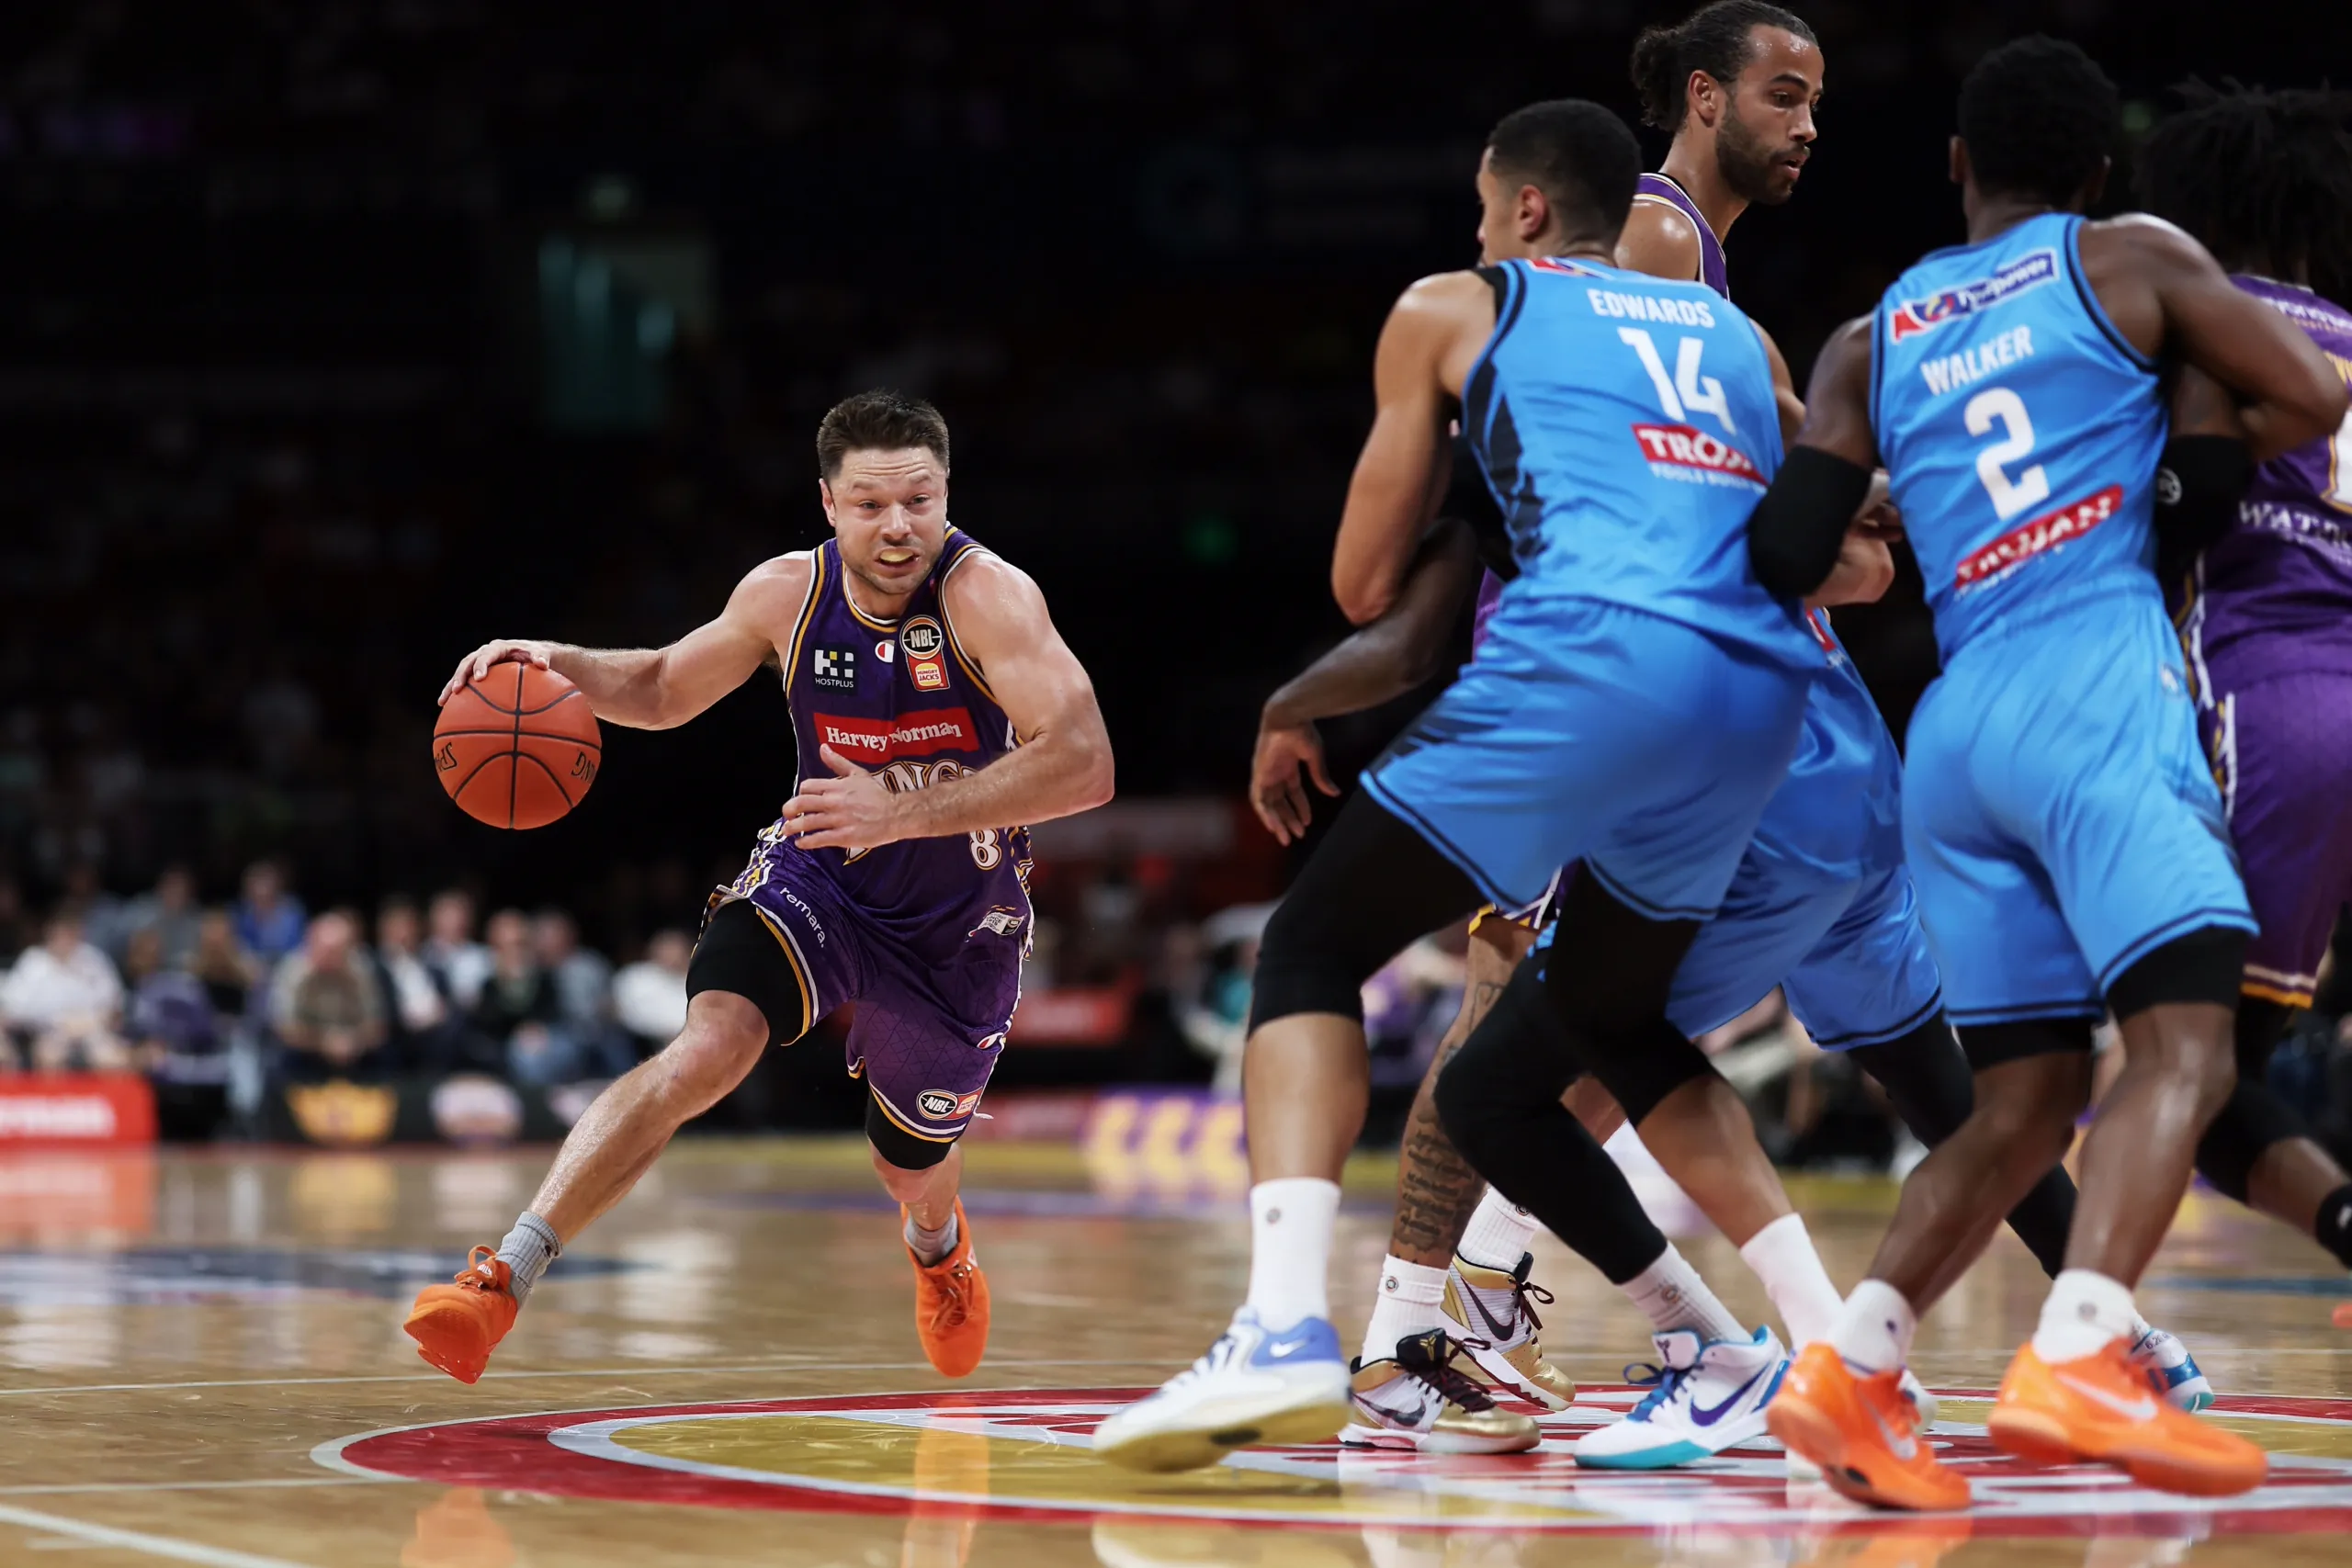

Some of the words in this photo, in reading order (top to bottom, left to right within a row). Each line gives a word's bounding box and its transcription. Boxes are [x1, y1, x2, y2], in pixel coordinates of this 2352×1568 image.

[1587, 288, 1715, 329] EDWARDS
[1617, 326, 1737, 437] 14
[1919, 324, 2036, 396] WALKER
[1637, 427, 1753, 471] TRO
[1963, 387, 2050, 521] 2
[910, 628, 935, 649] NBL
[815, 677, 854, 688] HOSTPLUS
[825, 726, 888, 751] Harvey
[888, 721, 963, 743] Norman
[969, 827, 1002, 871] 8
[779, 886, 826, 948] remara.
[924, 1095, 951, 1113] NBL
